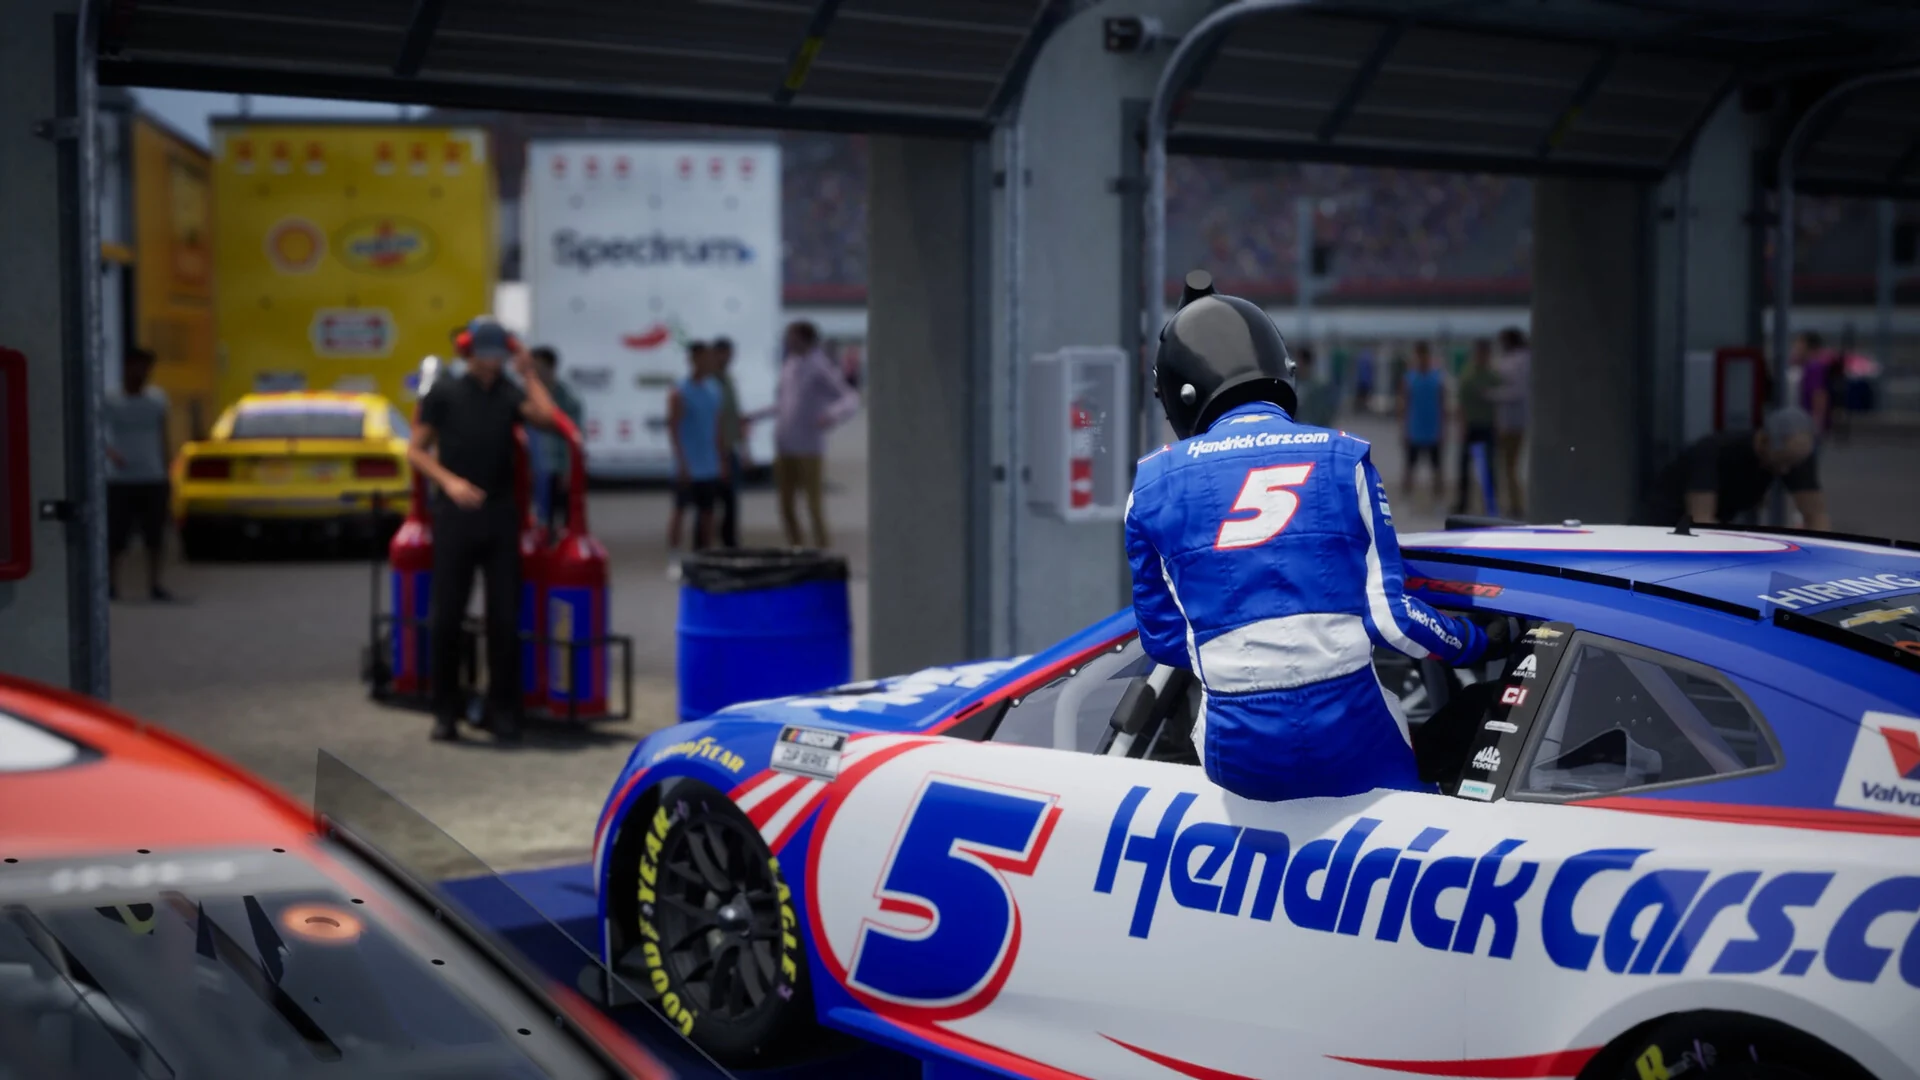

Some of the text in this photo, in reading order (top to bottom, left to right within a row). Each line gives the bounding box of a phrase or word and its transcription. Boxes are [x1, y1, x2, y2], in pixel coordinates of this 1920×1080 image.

[552, 227, 750, 275] Spectrum
[1187, 433, 1329, 458] HendrickCars.com
[1213, 462, 1316, 550] 5
[1757, 574, 1920, 609] HIRING
[651, 736, 745, 774] GOODYEAR
[1472, 761, 1498, 772] TOOLS
[848, 774, 1062, 1014] 5
[1093, 785, 1920, 989] HendrickCars.c
[637, 805, 695, 1036] GOODYEAR
